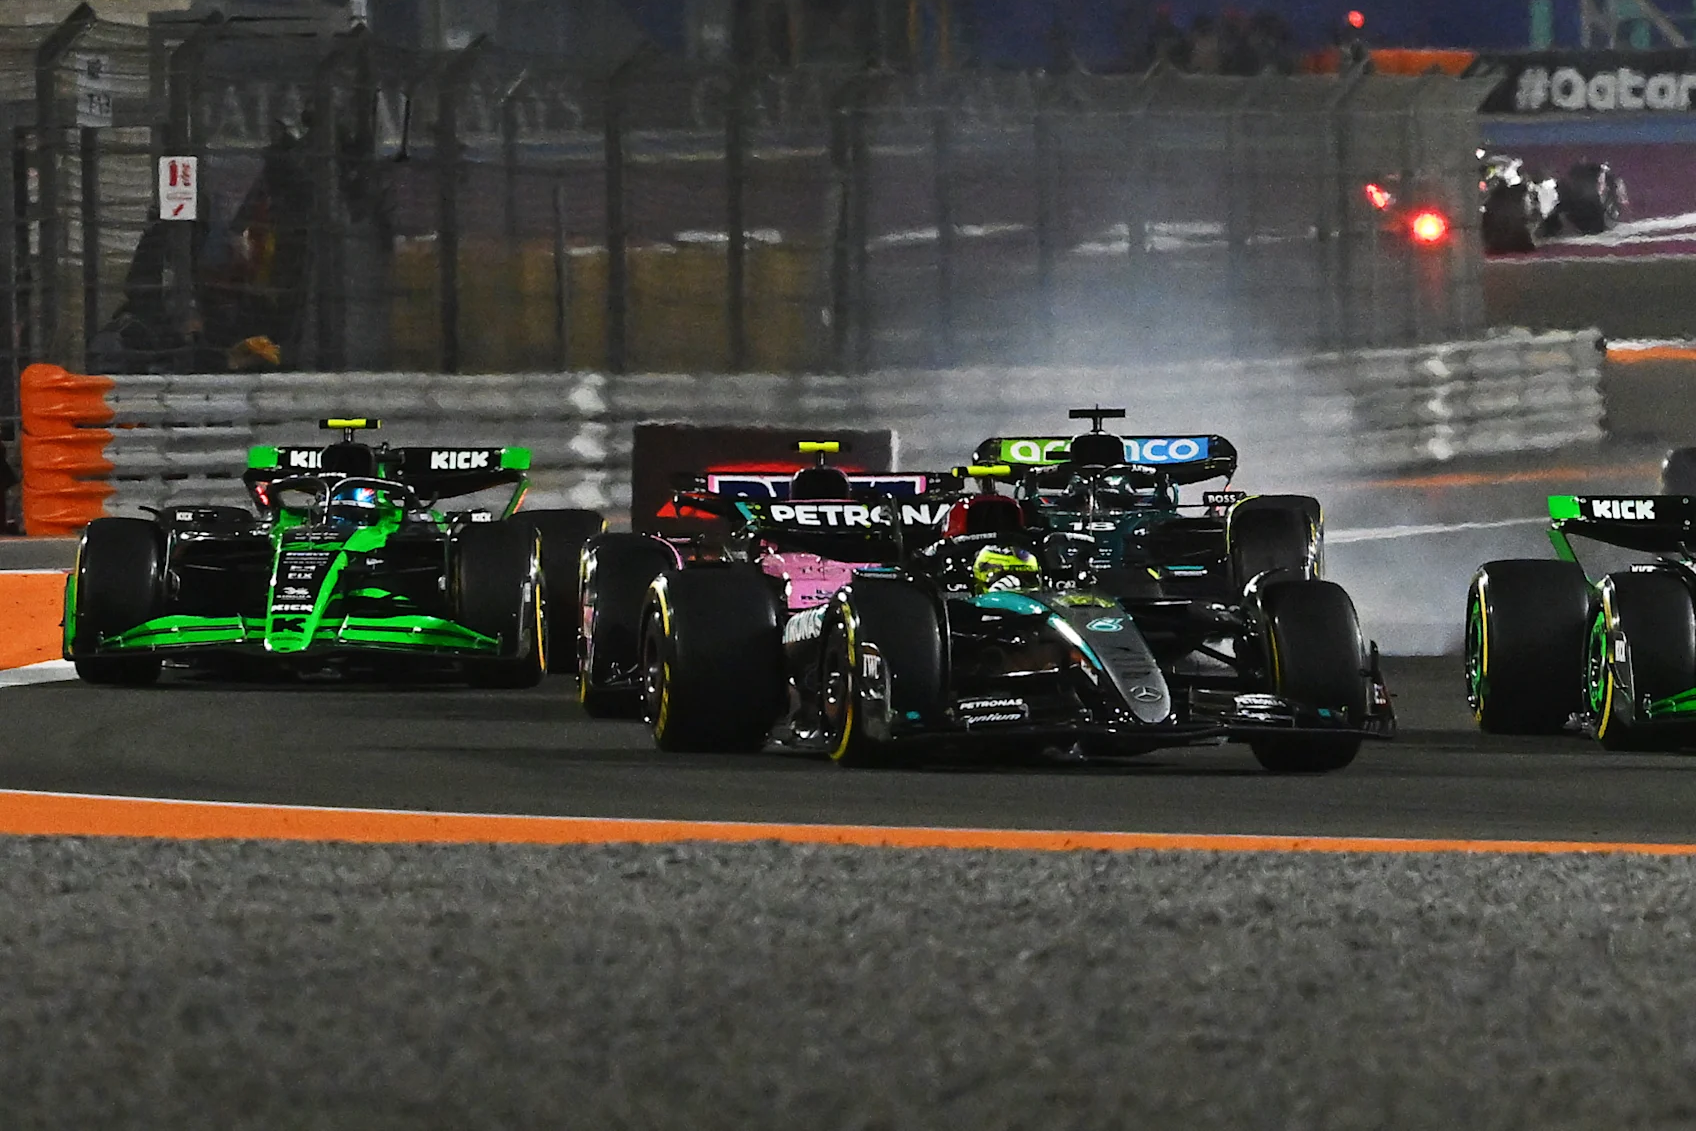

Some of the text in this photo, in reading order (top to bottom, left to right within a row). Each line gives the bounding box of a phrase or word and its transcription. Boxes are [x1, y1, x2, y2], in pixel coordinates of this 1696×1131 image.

[430, 450, 489, 470] KICK
[1009, 439, 1200, 462] arco
[1208, 494, 1236, 504] BOSS
[1592, 499, 1656, 520] KICK
[959, 698, 1023, 710] PETRONAS
